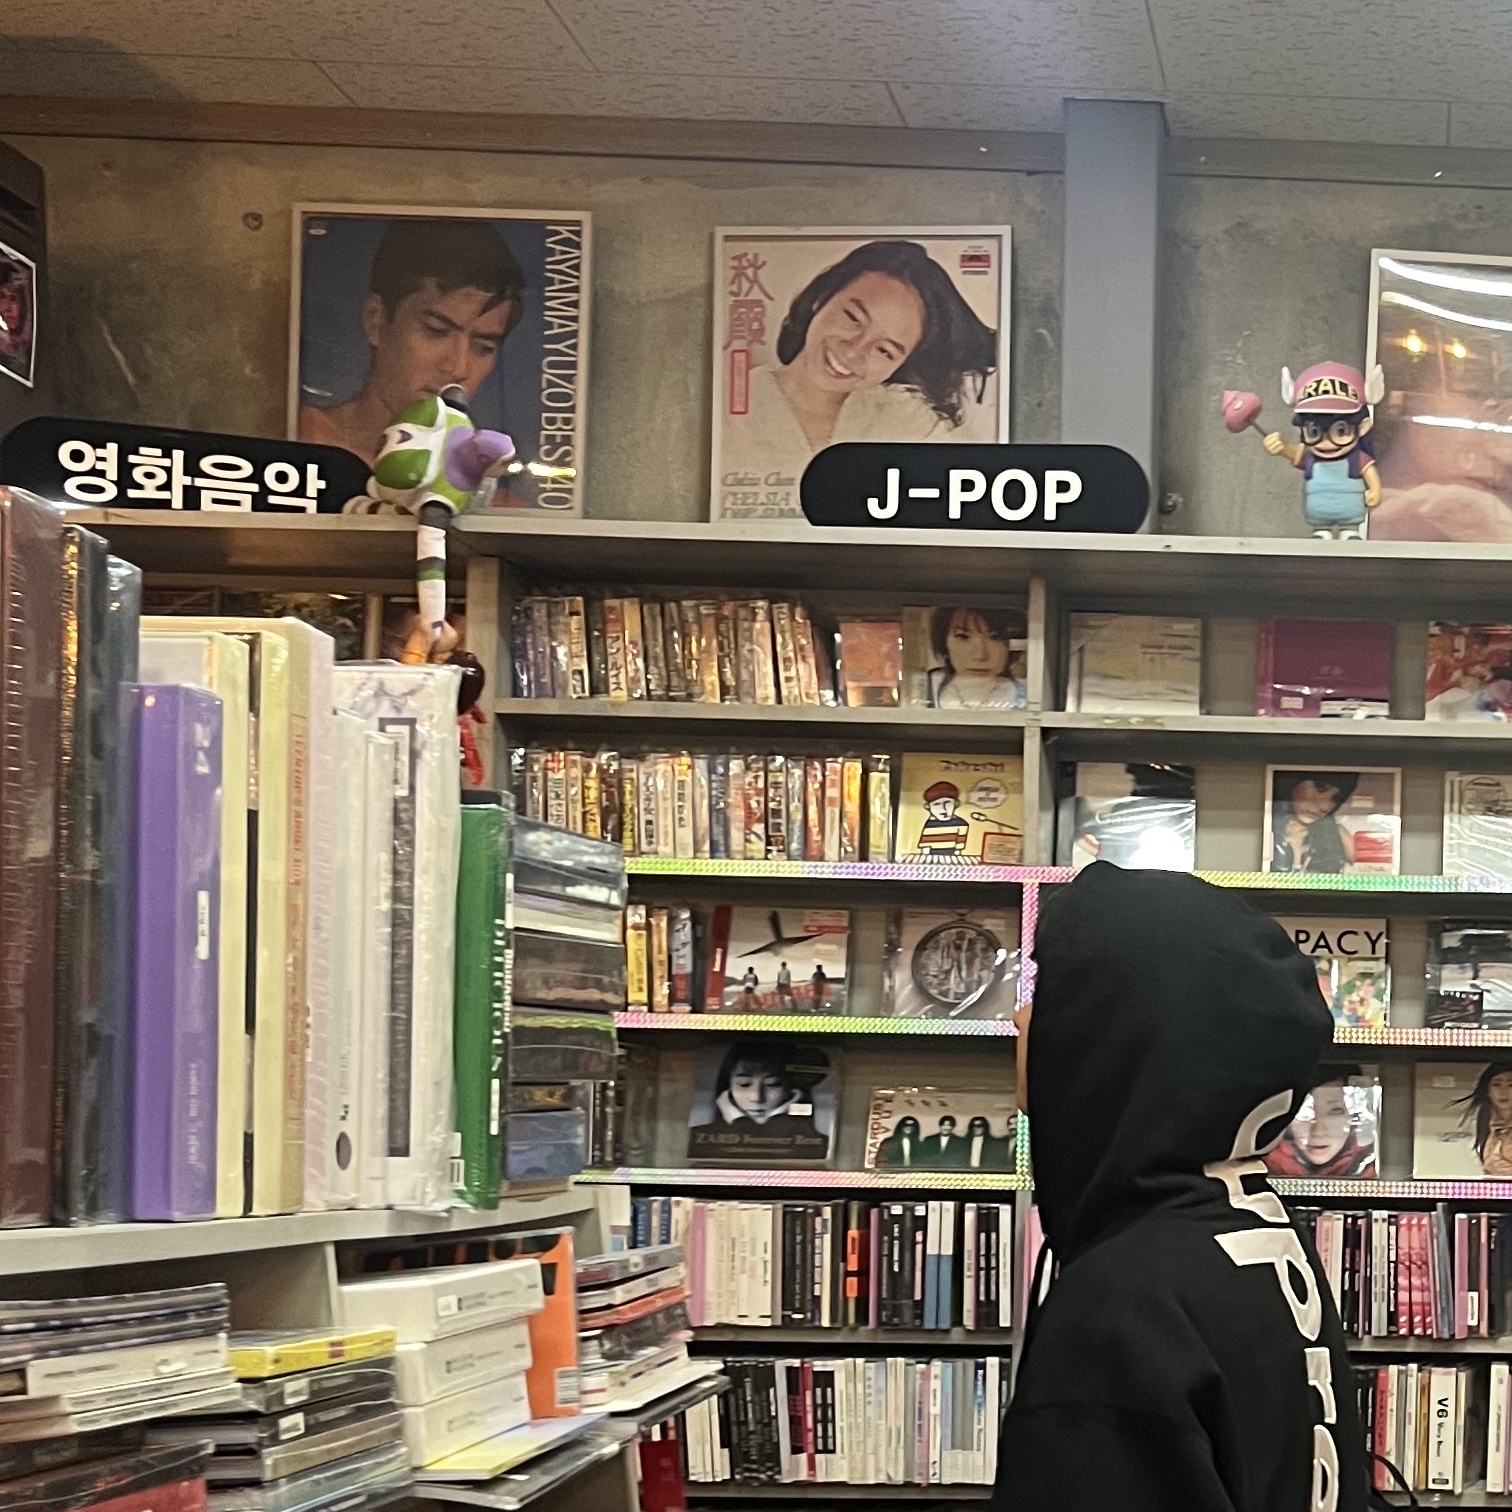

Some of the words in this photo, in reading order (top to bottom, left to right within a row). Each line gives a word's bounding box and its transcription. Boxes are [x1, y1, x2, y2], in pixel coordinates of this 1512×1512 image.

[543, 225, 582, 335] KAYAMA
[540, 339, 578, 414] YUZO
[1298, 378, 1359, 400] RALE
[57, 438, 327, 515] 영화음악
[867, 468, 1083, 521] J-POP
[1436, 1397, 1449, 1419] V6
